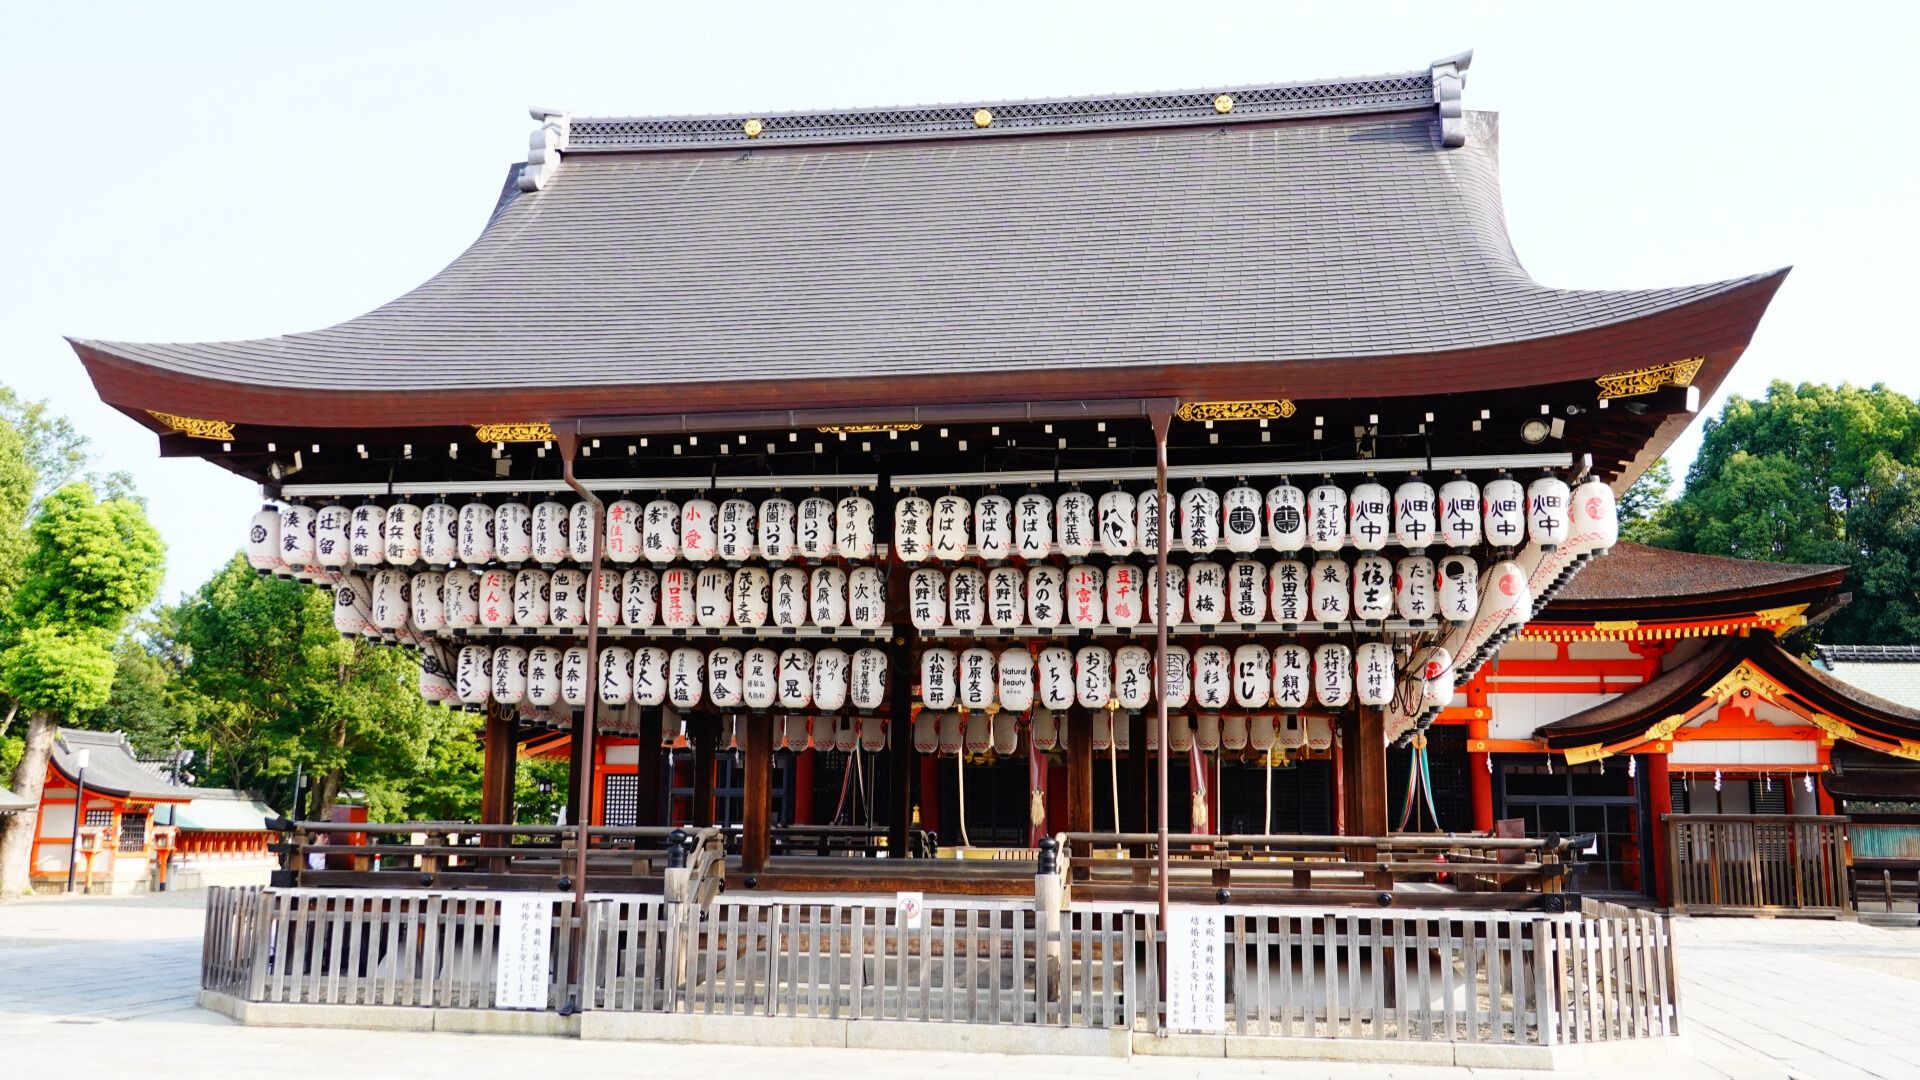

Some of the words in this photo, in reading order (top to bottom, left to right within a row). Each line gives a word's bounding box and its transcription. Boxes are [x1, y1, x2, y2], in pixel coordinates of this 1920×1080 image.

[283, 511, 300, 552] 湊家
[319, 513, 335, 555] 辻留
[354, 508, 370, 557] 権兵衛
[387, 507, 405, 558] 権兵衛
[685, 506, 702, 549] 小愛
[723, 502, 737, 556] 祇園いづ重
[766, 502, 780, 556] 祇園いづ重
[804, 500, 818, 552] 祇園いづ重
[841, 499, 858, 552] 菊の井
[901, 501, 919, 555] 美濃幸
[938, 499, 957, 551] 京ばん
[981, 499, 1000, 549] 京ばん
[1022, 498, 1040, 549] 京ばん
[1189, 493, 1208, 548] 八木源太郎
[1317, 507, 1327, 542] 美容室
[1329, 505, 1339, 536] アービル
[1356, 501, 1383, 543] 畑中
[1401, 499, 1428, 541] 畑中
[1448, 498, 1475, 539] 畑中
[1491, 500, 1516, 536] 畑中
[1533, 494, 1561, 536] 畑中
[518, 573, 531, 619] キメラ
[554, 573, 569, 621] 池田家
[627, 570, 644, 623] 美の八重
[701, 574, 716, 616] 川口
[854, 583, 869, 621] 次朗
[915, 573, 930, 622] 矢野一郎
[955, 573, 971, 623] 矢野一郎
[995, 573, 1012, 623] 矢野一郎
[1035, 572, 1053, 620] みの家
[1076, 572, 1093, 622] 小富美
[1114, 570, 1131, 618] 豆千鶴
[1196, 569, 1215, 612] 桝梅
[1238, 565, 1255, 616] 田崎真也
[1322, 565, 1341, 611] 泉政
[1410, 563, 1425, 615] たに本
[532, 649, 548, 698] 元奈古
[565, 651, 581, 699] 元奈古
[678, 652, 686, 672] 株式会社
[751, 653, 764, 677] 北尾
[784, 653, 802, 698] 大晃
[929, 653, 945, 704] 小松陽一郎
[967, 654, 983, 703] 伊原友己
[1002, 667, 1027, 675] Natural
[1002, 678, 1026, 688] Beauty
[1046, 653, 1065, 702] いちえ
[1085, 653, 1100, 701] おくむら
[1204, 651, 1220, 704] 満彩美
[1239, 661, 1255, 700] にし
[1281, 650, 1301, 702] 筧絹代
[1324, 649, 1341, 703] 北村クリニック
[1368, 661, 1382, 699] 北村健
[673, 674, 689, 701] 天塩
[1190, 916, 1200, 1025] 結婚式をお受けします
